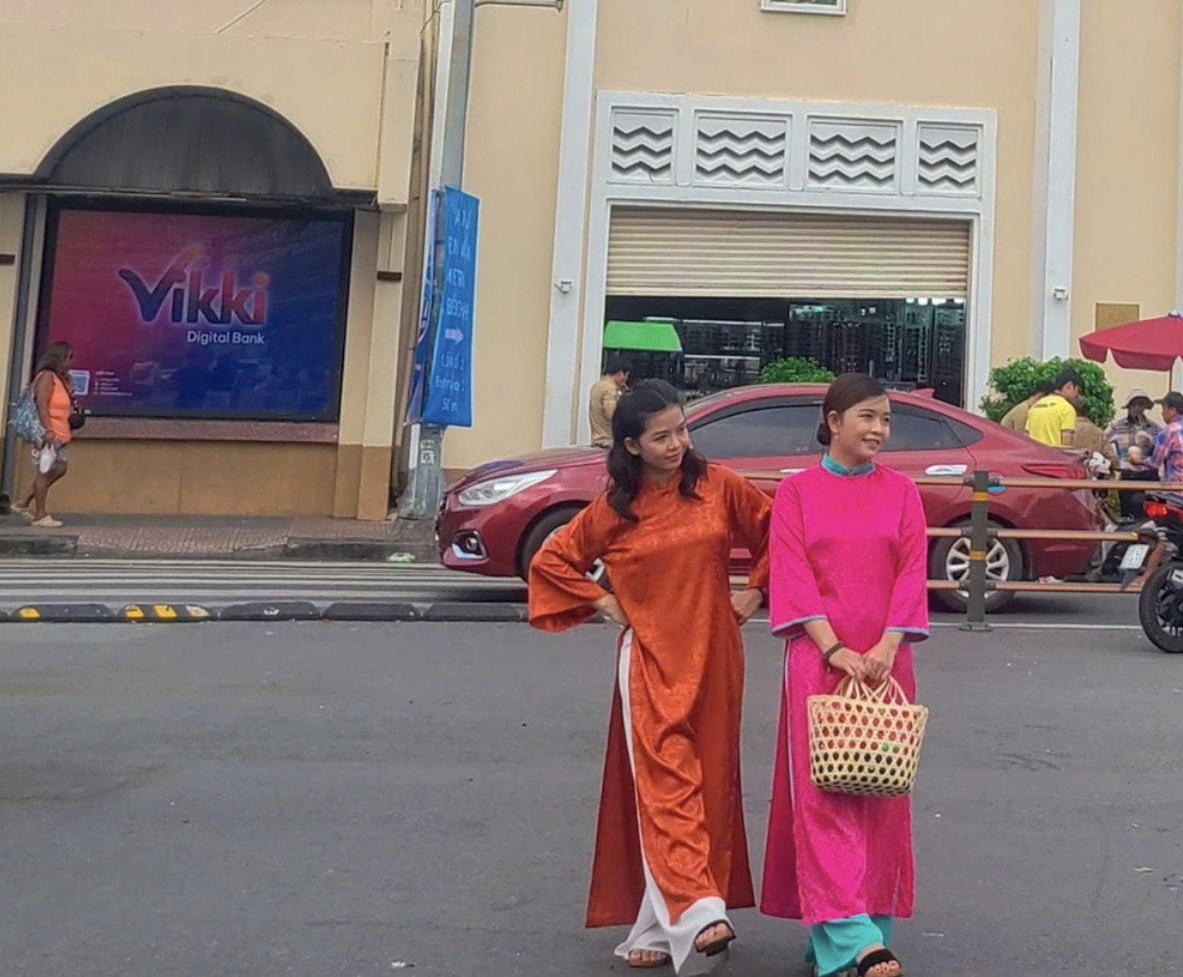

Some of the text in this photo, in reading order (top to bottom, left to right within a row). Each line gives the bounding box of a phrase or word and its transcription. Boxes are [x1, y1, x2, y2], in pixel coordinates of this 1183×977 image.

[118, 245, 270, 325] Vikki
[187, 330, 265, 346] Digital Bank
